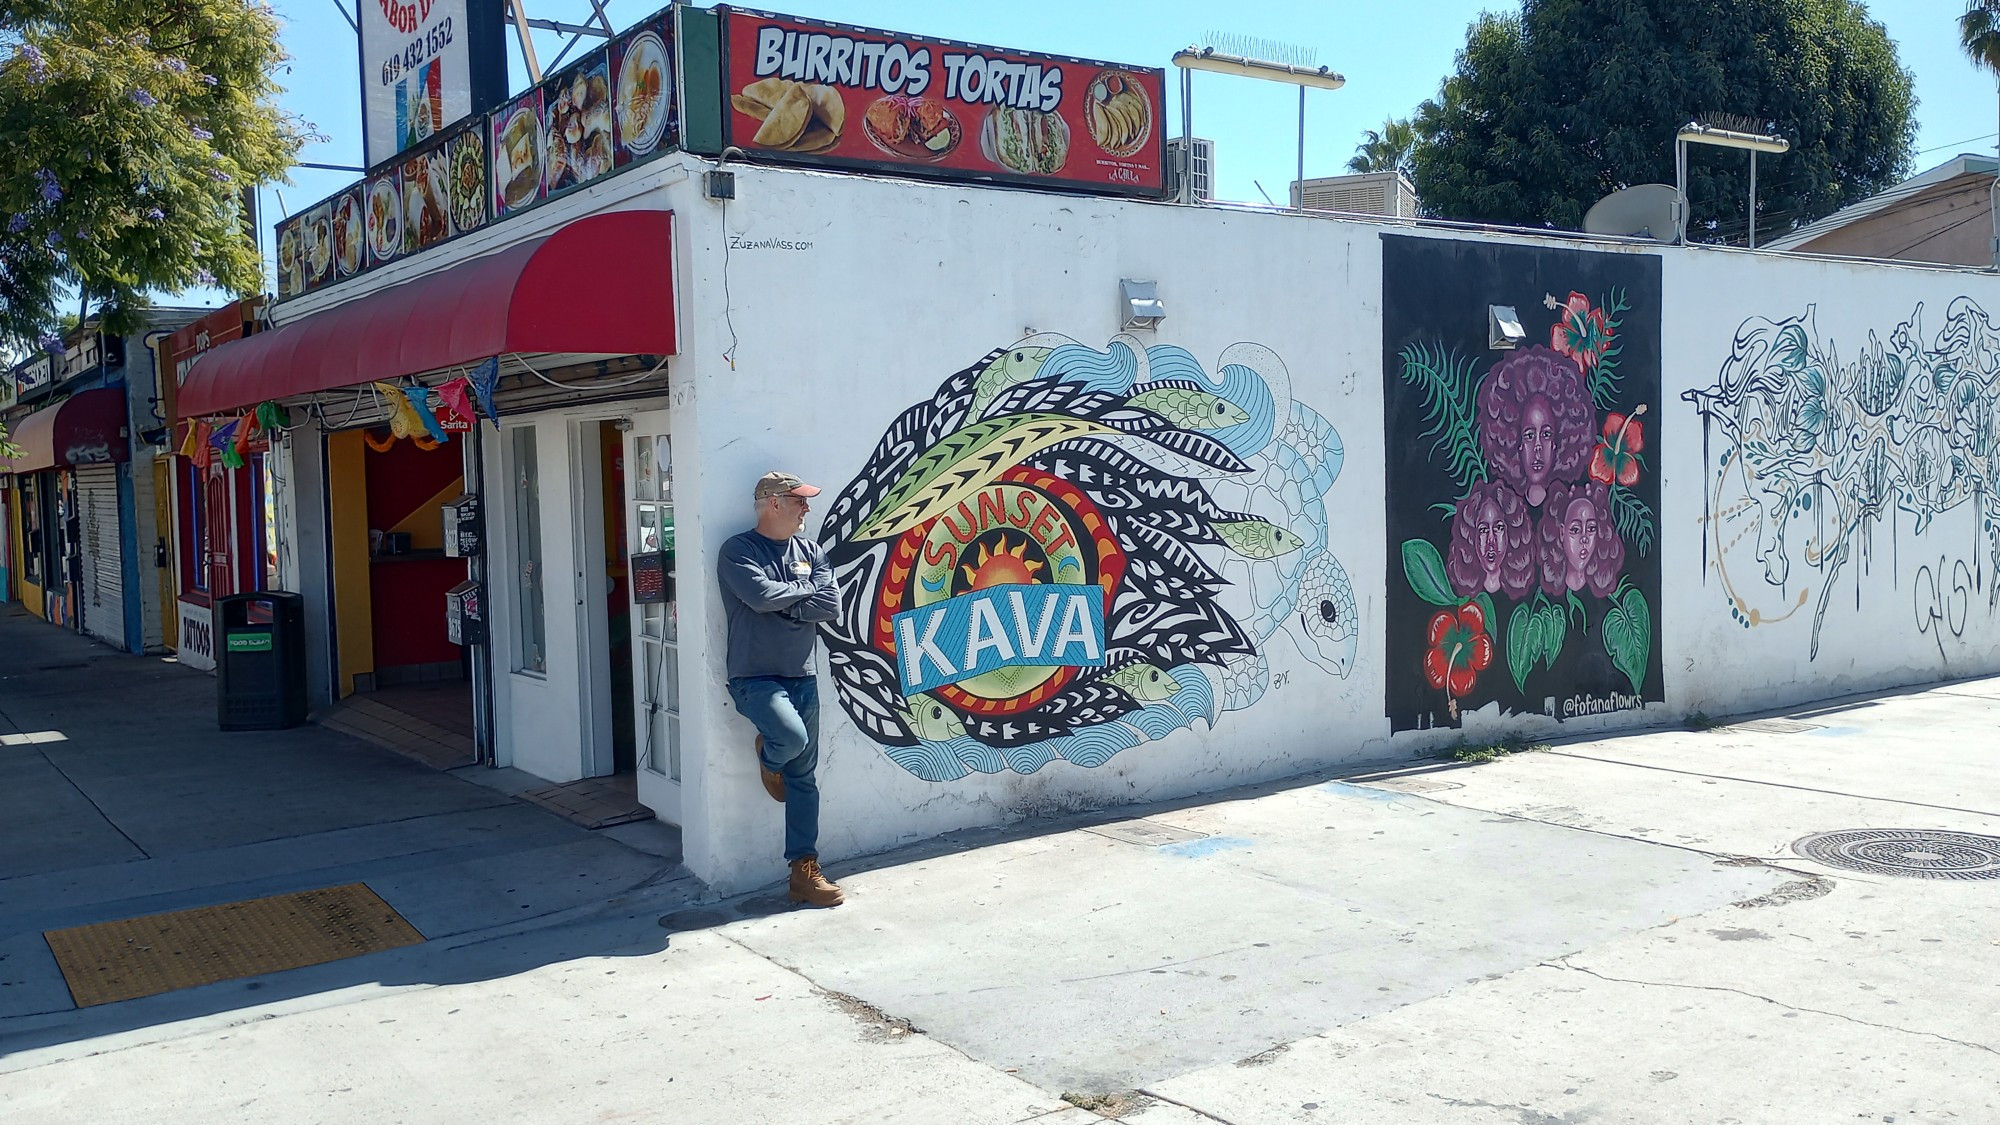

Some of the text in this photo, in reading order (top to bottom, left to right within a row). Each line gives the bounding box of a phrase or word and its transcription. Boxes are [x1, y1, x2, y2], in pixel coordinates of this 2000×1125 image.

[382, 16, 453, 86] 619 432 1552
[755, 27, 1063, 112] BURRITOS TORTAS
[440, 420, 468, 429] Sarita
[924, 487, 1076, 571] SUNSET
[900, 590, 1100, 686] KAVA
[1563, 690, 1643, 717] @fofanaflowrs
